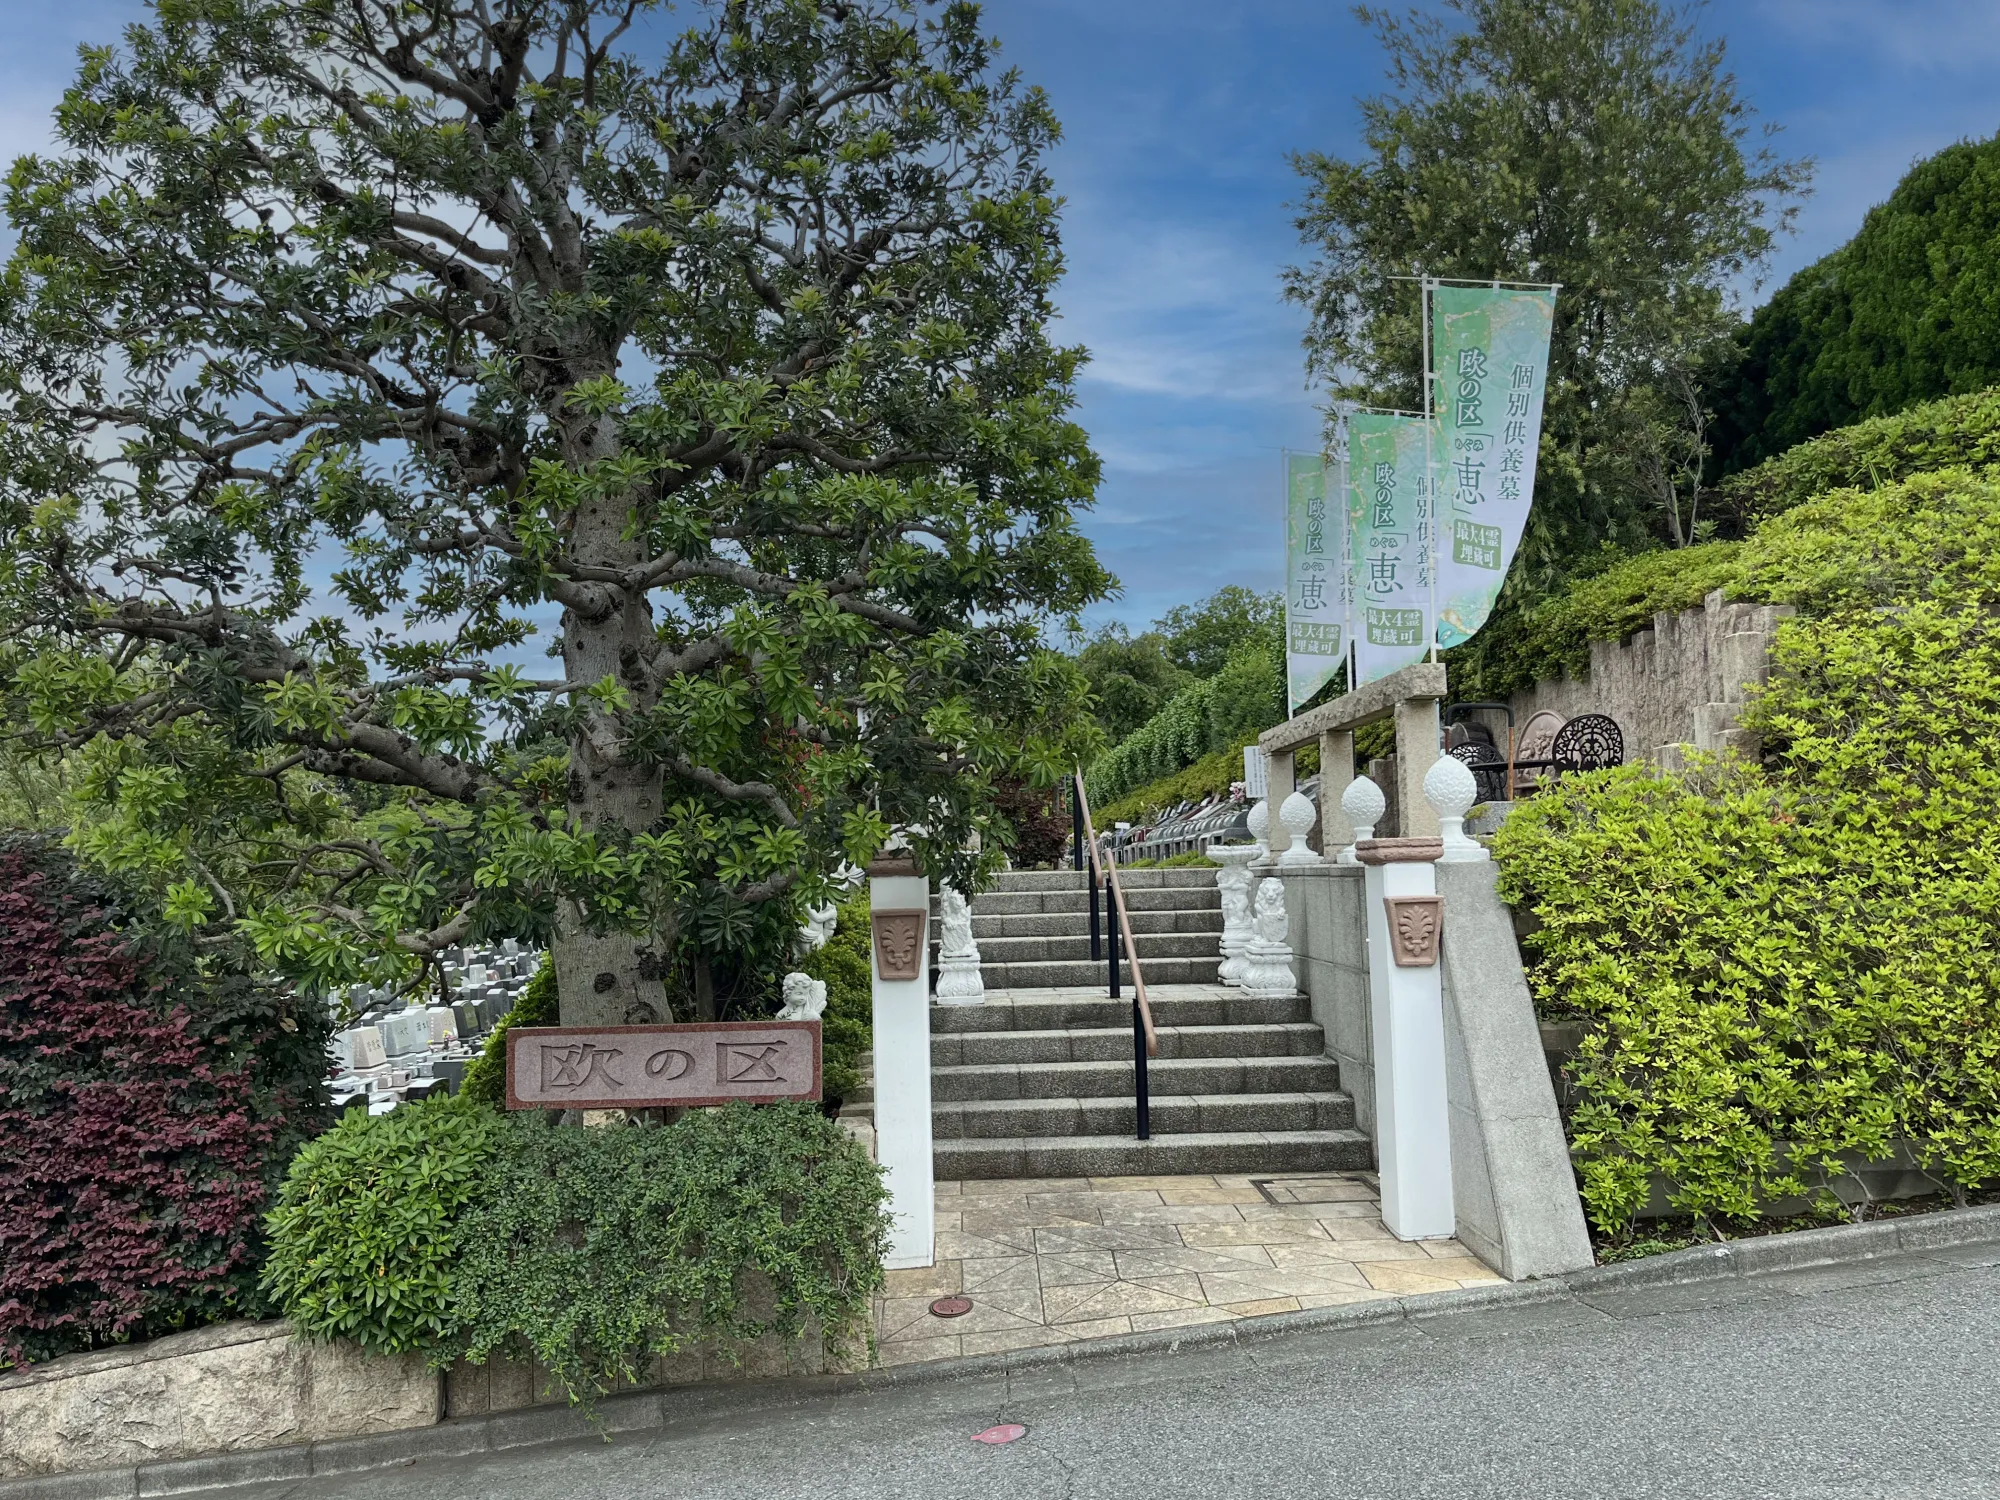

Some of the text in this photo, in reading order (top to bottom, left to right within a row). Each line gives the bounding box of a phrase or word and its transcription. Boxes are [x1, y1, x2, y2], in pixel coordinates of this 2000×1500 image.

[1456, 347, 1488, 428] 欧の区
[1497, 363, 1534, 500] 個別供養墓
[1455, 438, 1484, 451] めぐみ
[1373, 462, 1397, 528] 欧の区
[1305, 497, 1326, 554] 欧の区
[1456, 521, 1500, 548] 最大4霊
[1370, 537, 1398, 548] めぐみ
[1301, 560, 1325, 571] めぐみ
[1460, 543, 1495, 568] 埋蔵可
[1368, 609, 1421, 627] 最大4霊
[1291, 622, 1339, 640] 最大4霊
[1372, 628, 1415, 645] 埋蔵可
[1294, 639, 1333, 654] 埋蔵可
[539, 1039, 788, 1093] 欧の区
